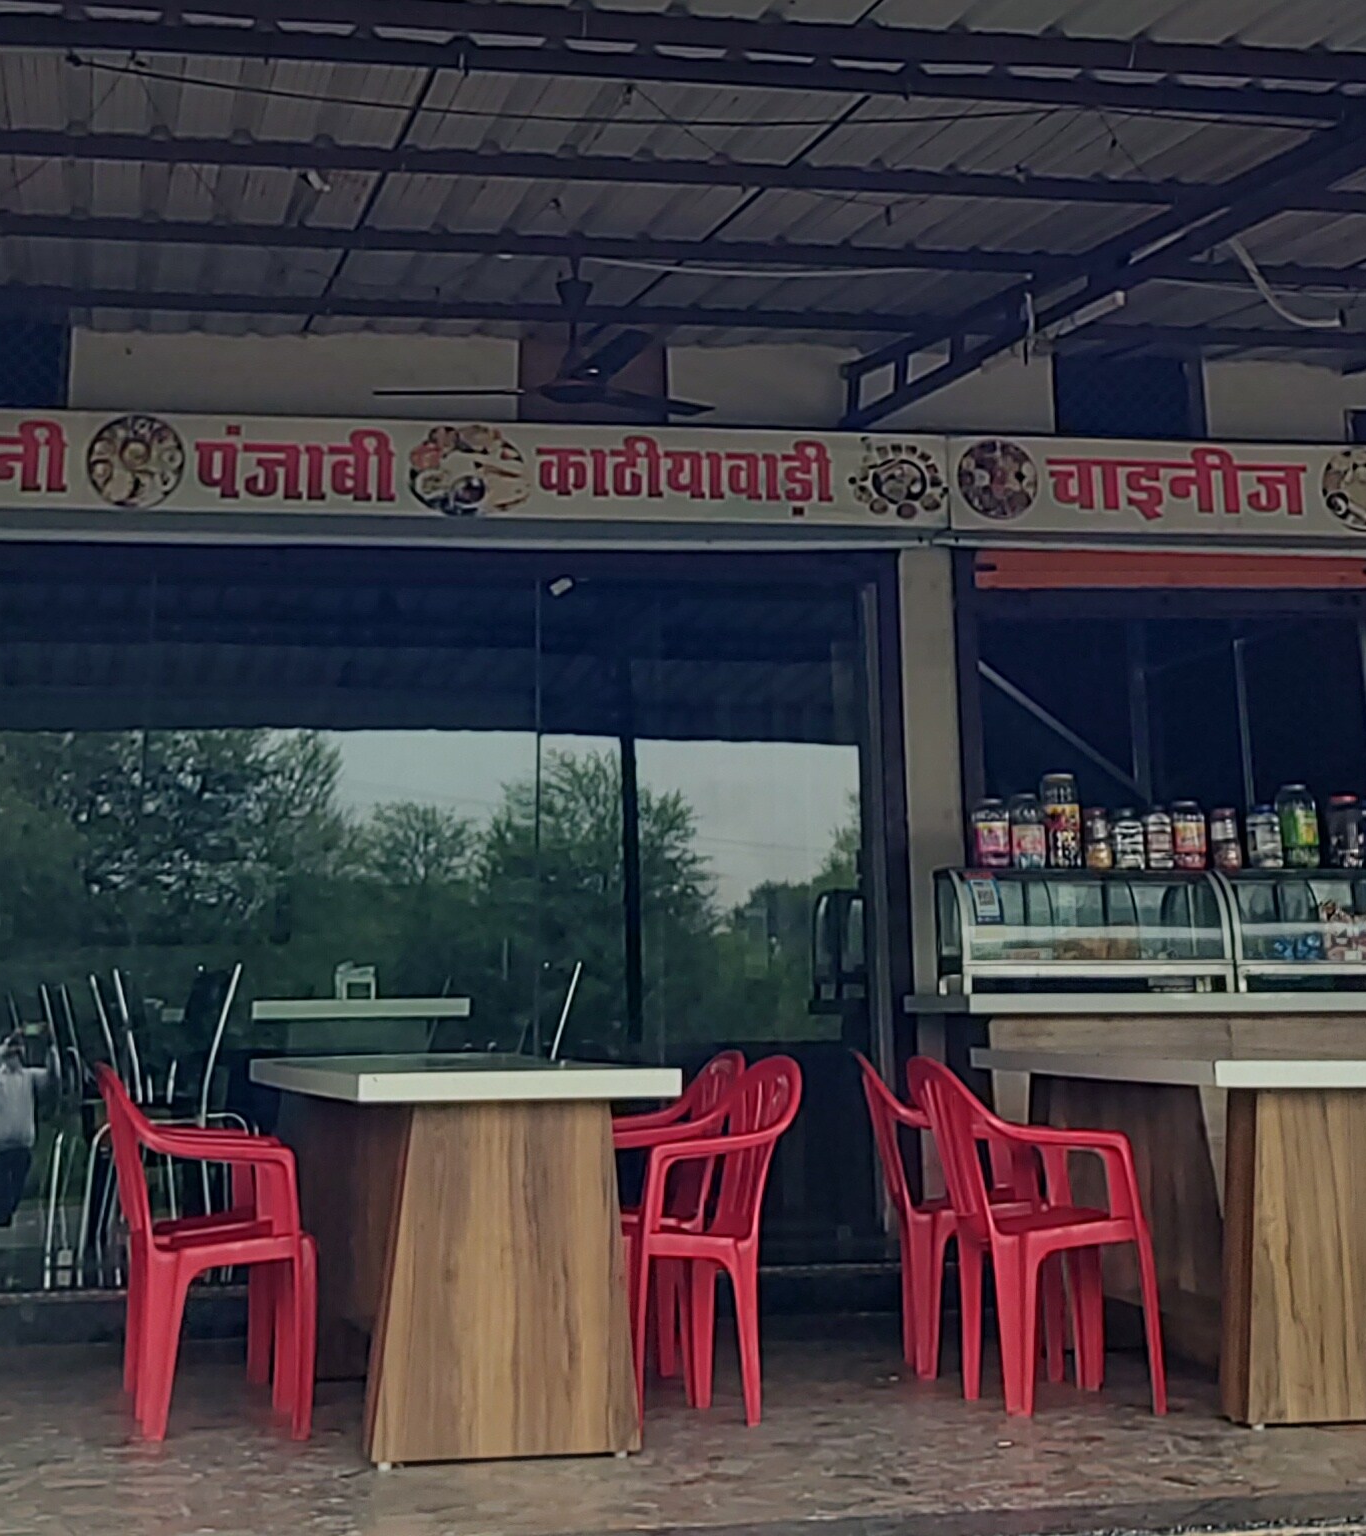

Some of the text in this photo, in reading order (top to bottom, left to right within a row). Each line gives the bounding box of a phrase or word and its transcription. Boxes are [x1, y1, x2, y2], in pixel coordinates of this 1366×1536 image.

[195, 425, 396, 502] पंजाबी
[536, 435, 834, 517] काठीयावाड़ी
[1045, 447, 1308, 521] चाइनीज
